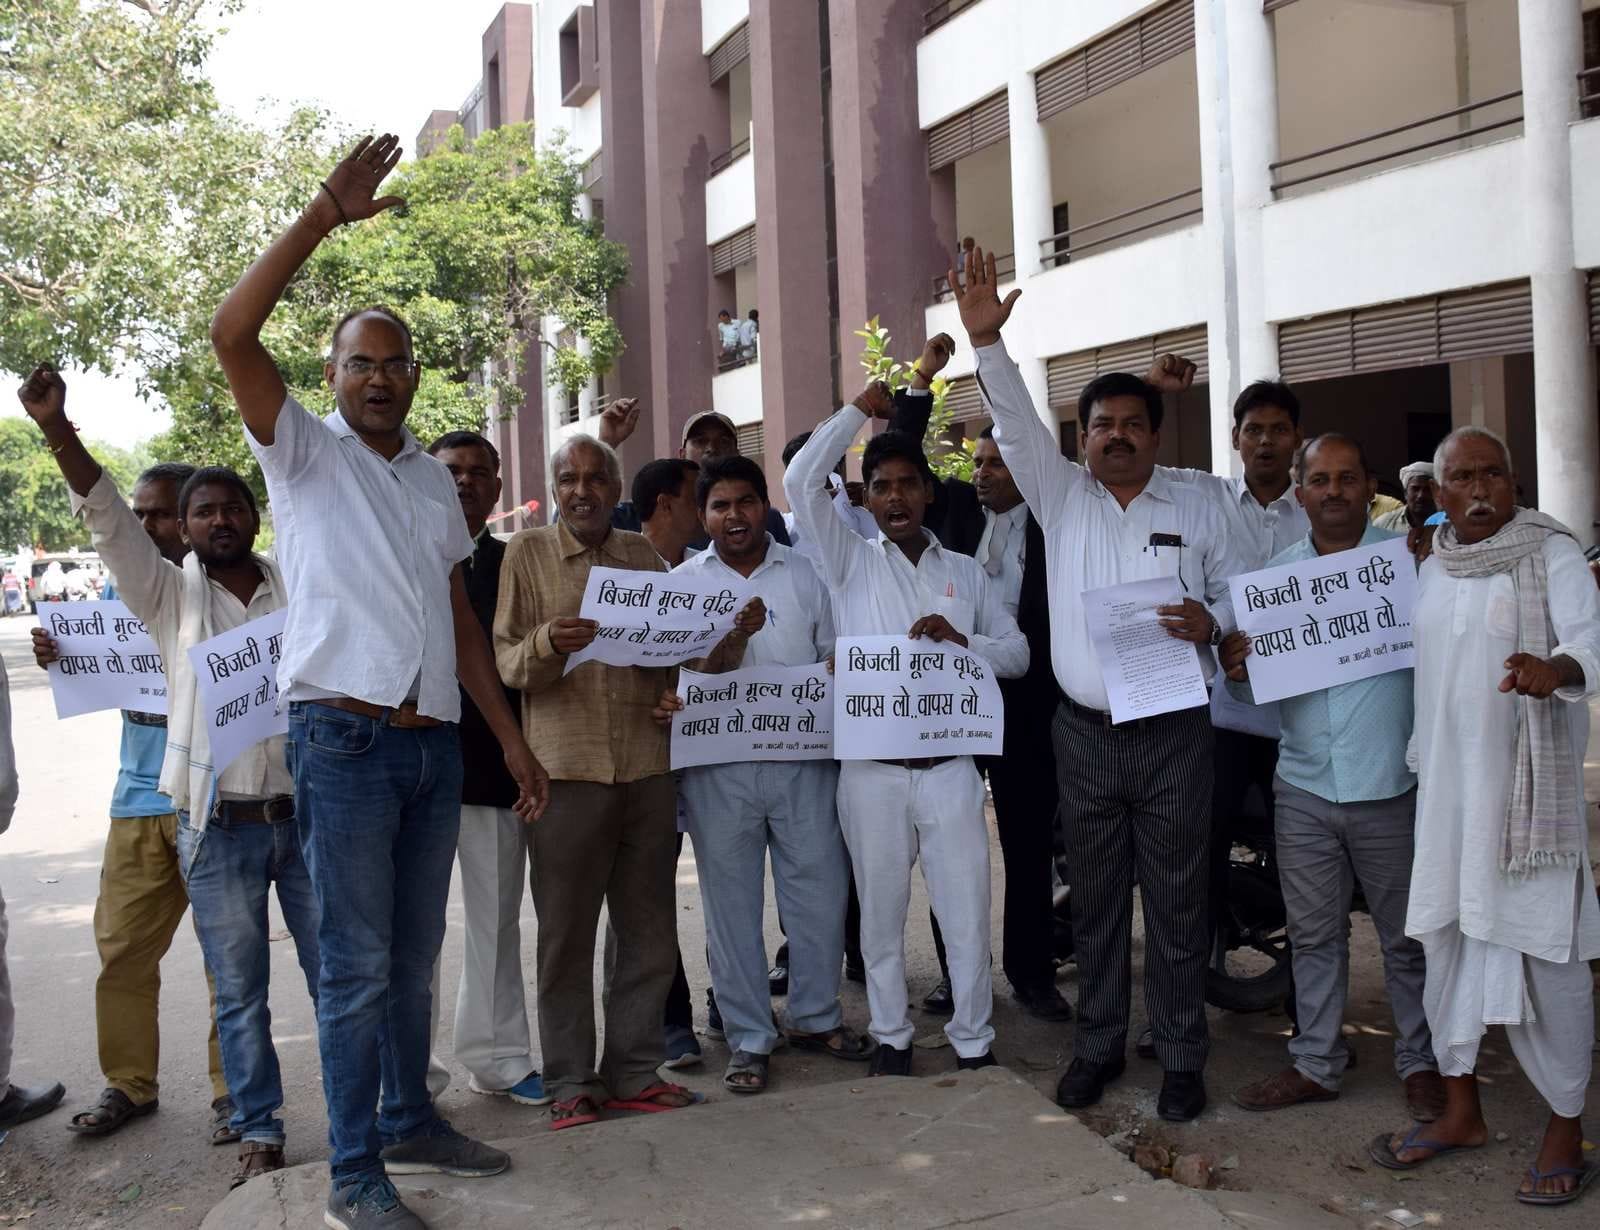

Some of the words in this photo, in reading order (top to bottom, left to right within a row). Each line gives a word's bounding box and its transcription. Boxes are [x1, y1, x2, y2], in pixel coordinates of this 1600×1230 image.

[597, 579, 653, 607] बिजली
[657, 590, 696, 616] मूल्य
[703, 590, 738, 617] वृद्धि
[1245, 575, 1302, 612] बिजली
[1309, 571, 1350, 605] मूल्य
[1356, 555, 1395, 593] वृद्धि
[50, 611, 105, 637] बिजली
[594, 627, 625, 640] ापस
[1251, 628, 1297, 658] वापस
[57, 655, 100, 676] वापस
[207, 637, 261, 683] बिजली
[847, 646, 901, 672] बिजली
[909, 652, 944, 679] मूल्य
[954, 655, 985, 681] वृद्धि
[686, 681, 738, 706] बिजली
[745, 682, 782, 703] मूल्य
[791, 677, 826, 705] वृद्धि
[846, 694, 885, 717] वापस
[215, 692, 250, 728] वापस
[682, 717, 719, 737] वापस
